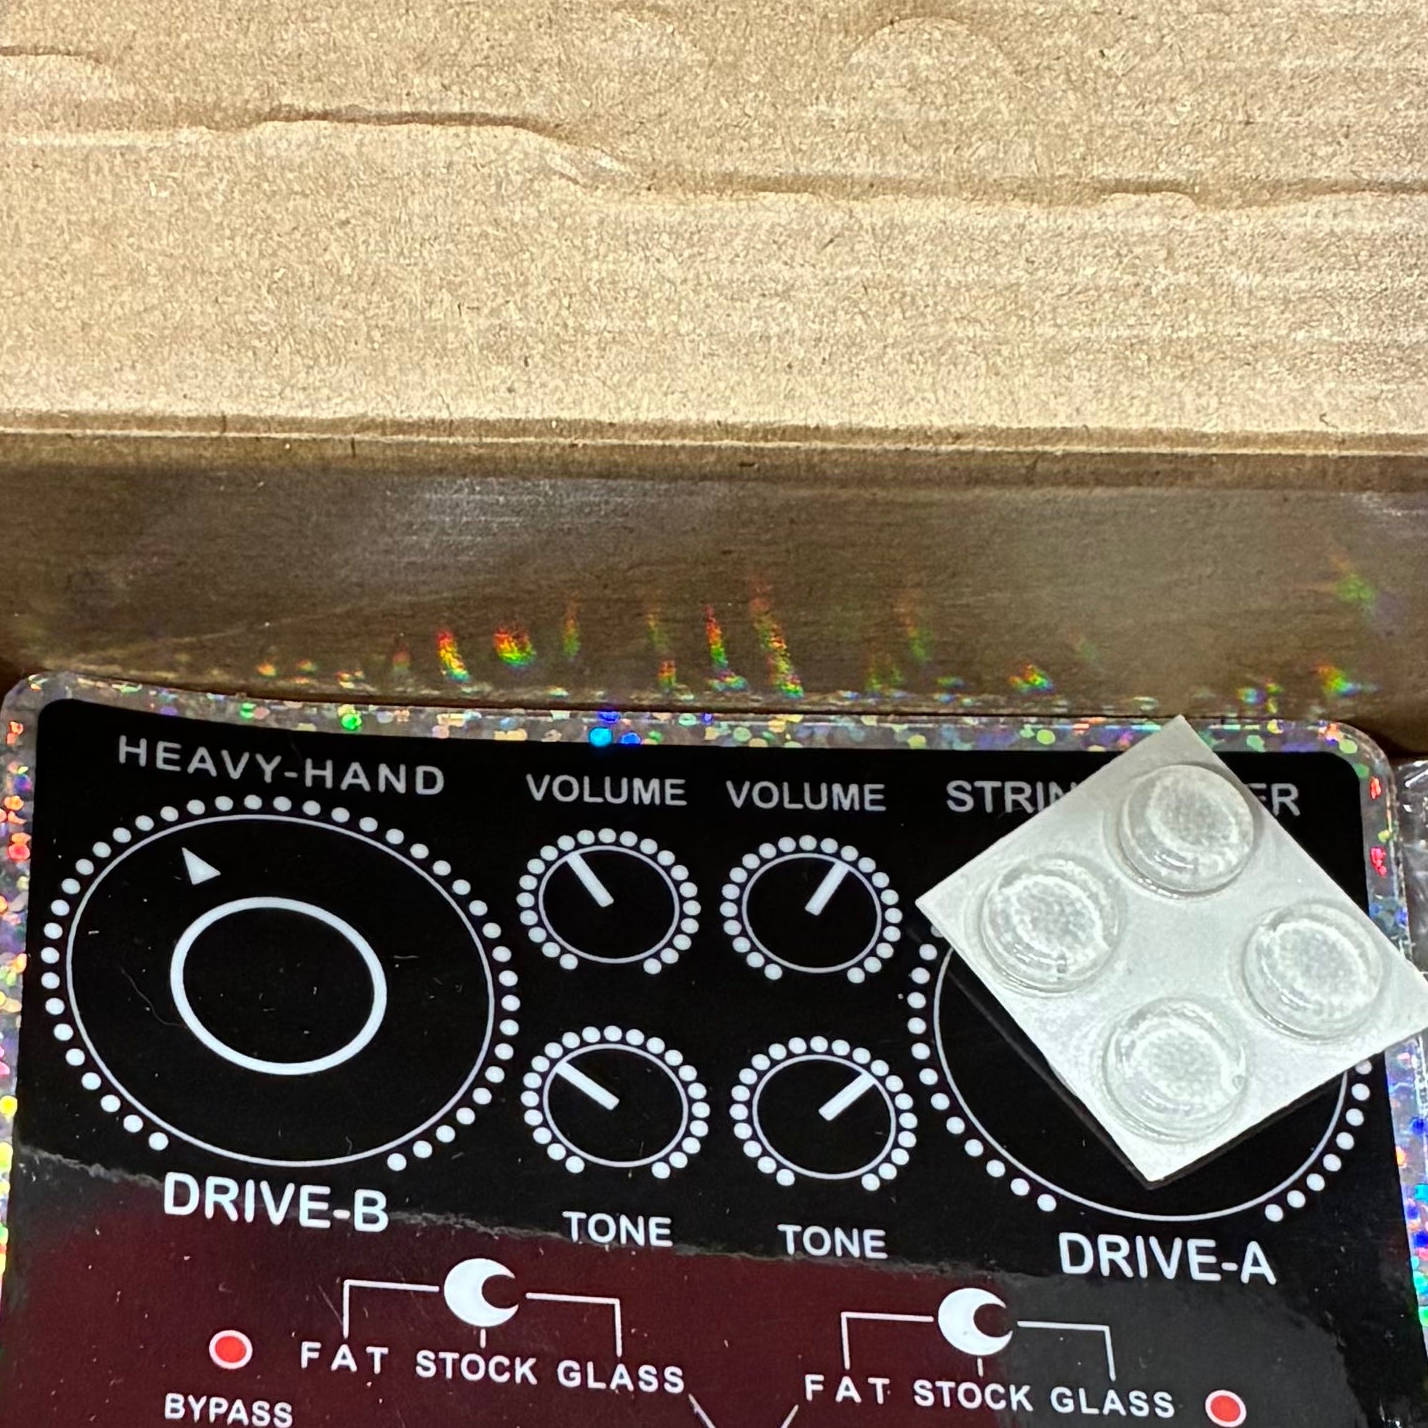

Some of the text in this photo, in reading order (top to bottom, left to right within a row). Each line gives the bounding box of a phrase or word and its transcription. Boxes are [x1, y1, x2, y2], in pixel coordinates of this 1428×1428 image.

[118, 734, 445, 796] HEAVY-HAND
[526, 774, 687, 807] VOLUME
[726, 780, 886, 812] VOLUME
[163, 1171, 390, 1233] DRIVE-B
[561, 1210, 674, 1248] TONE
[777, 1223, 888, 1260] TONE
[1058, 1231, 1278, 1285] DRIVE-A
[300, 1340, 685, 1395] FAT STOCK GLASS
[804, 1373, 1175, 1420] FAT STOCK GLASS
